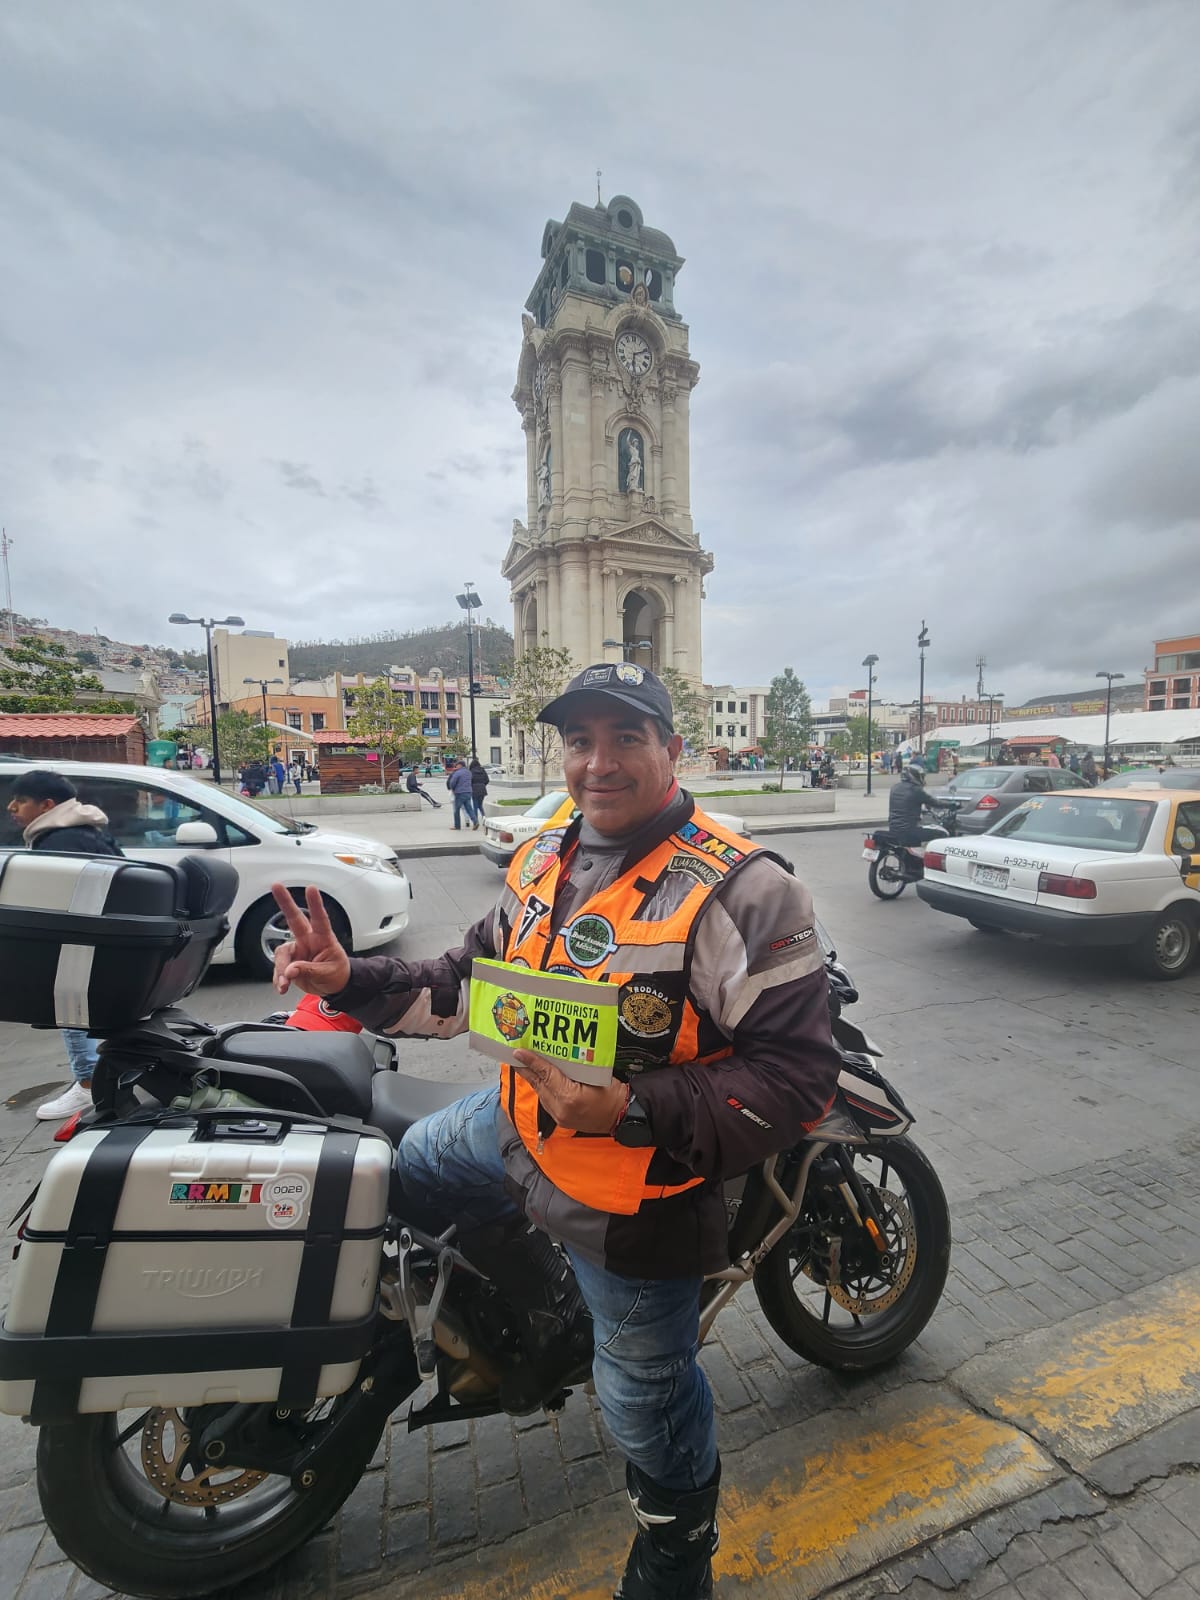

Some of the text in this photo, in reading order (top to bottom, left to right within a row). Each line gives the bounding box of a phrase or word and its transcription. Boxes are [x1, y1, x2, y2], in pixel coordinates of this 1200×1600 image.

[678, 823, 728, 857] RRM
[944, 846, 978, 859] PACHUCA
[770, 929, 814, 950] DRY-TECH
[633, 986, 669, 1003] RODADA
[534, 998, 599, 1020] MOTOTURISTA
[532, 1011, 598, 1048] RRM
[532, 1040, 568, 1058] MÉXICO
[171, 1184, 229, 1200] RRM
[273, 1185, 303, 1194] 0028
[141, 1267, 264, 1291] TRIUMPH
